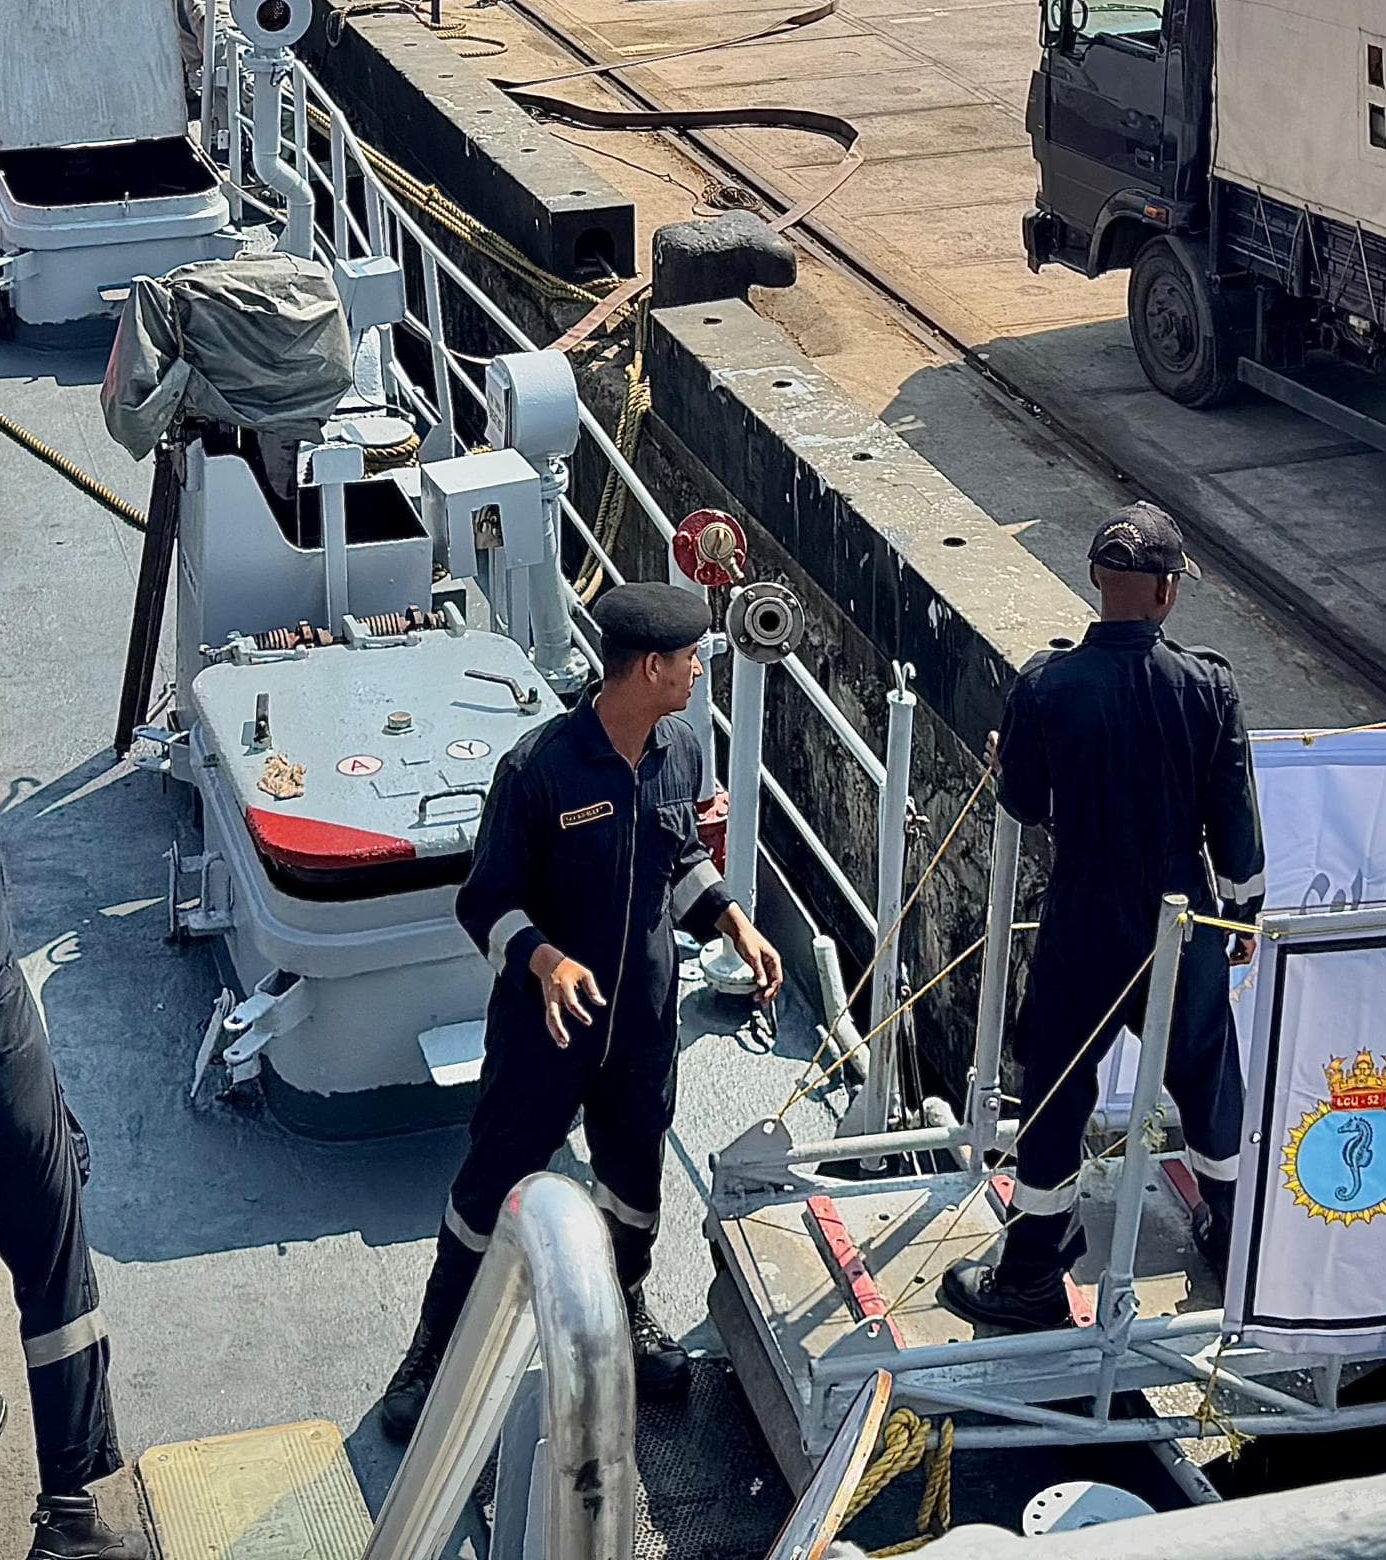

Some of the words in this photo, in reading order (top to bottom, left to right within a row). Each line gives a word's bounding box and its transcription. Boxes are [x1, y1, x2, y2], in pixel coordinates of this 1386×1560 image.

[351, 759, 370, 772] A
[455, 742, 474, 755] Y
[1336, 1096, 1359, 1107] LCU
[1367, 1094, 1380, 1105] 52
